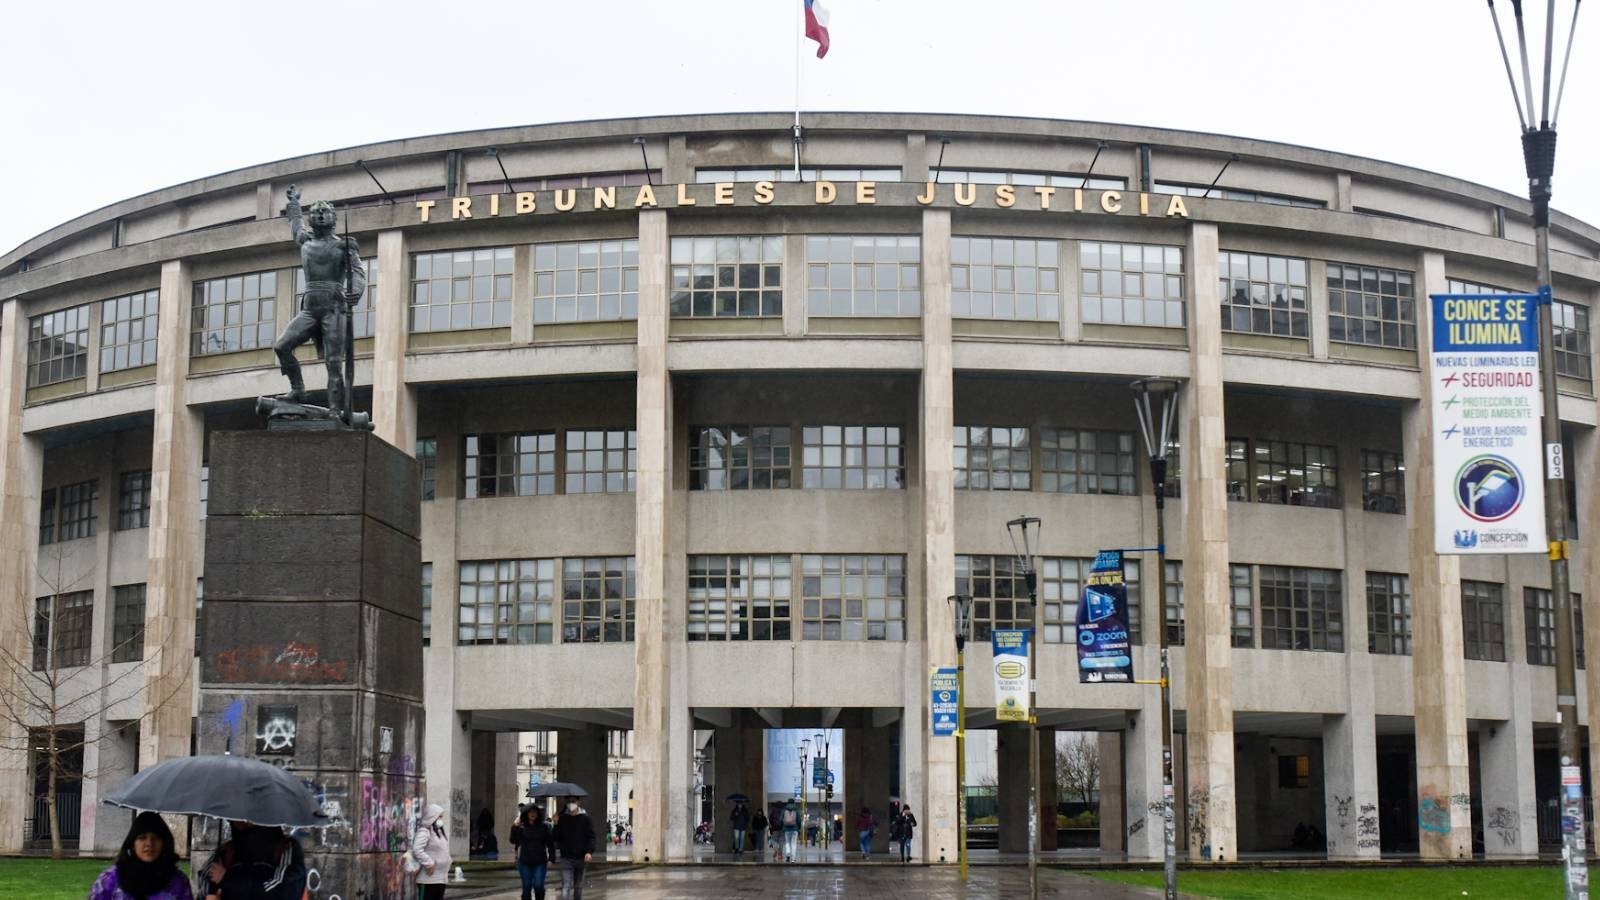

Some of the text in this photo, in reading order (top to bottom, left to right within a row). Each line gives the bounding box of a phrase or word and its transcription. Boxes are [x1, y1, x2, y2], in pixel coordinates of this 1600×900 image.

[415, 181, 1189, 222] TRIBUNALES DE JUSTICIA
[1444, 299, 1527, 321] CONCE SE
[1449, 323, 1522, 345] ILUMINA
[1436, 357, 1536, 367] NUEVAS LUMINARIAS LED
[1462, 372, 1533, 388] SEGURIDAD
[1463, 396, 1529, 407] PROTECCIÓN DEL
[1463, 409, 1532, 418] MEDIO AMBIENTE
[1463, 426, 1527, 436] MAYOR AHORRO
[1463, 437, 1514, 448] ENERGÉTICO
[1480, 532, 1528, 543] CONCEPCIÓN
[1100, 575, 1123, 585] ONLINE
